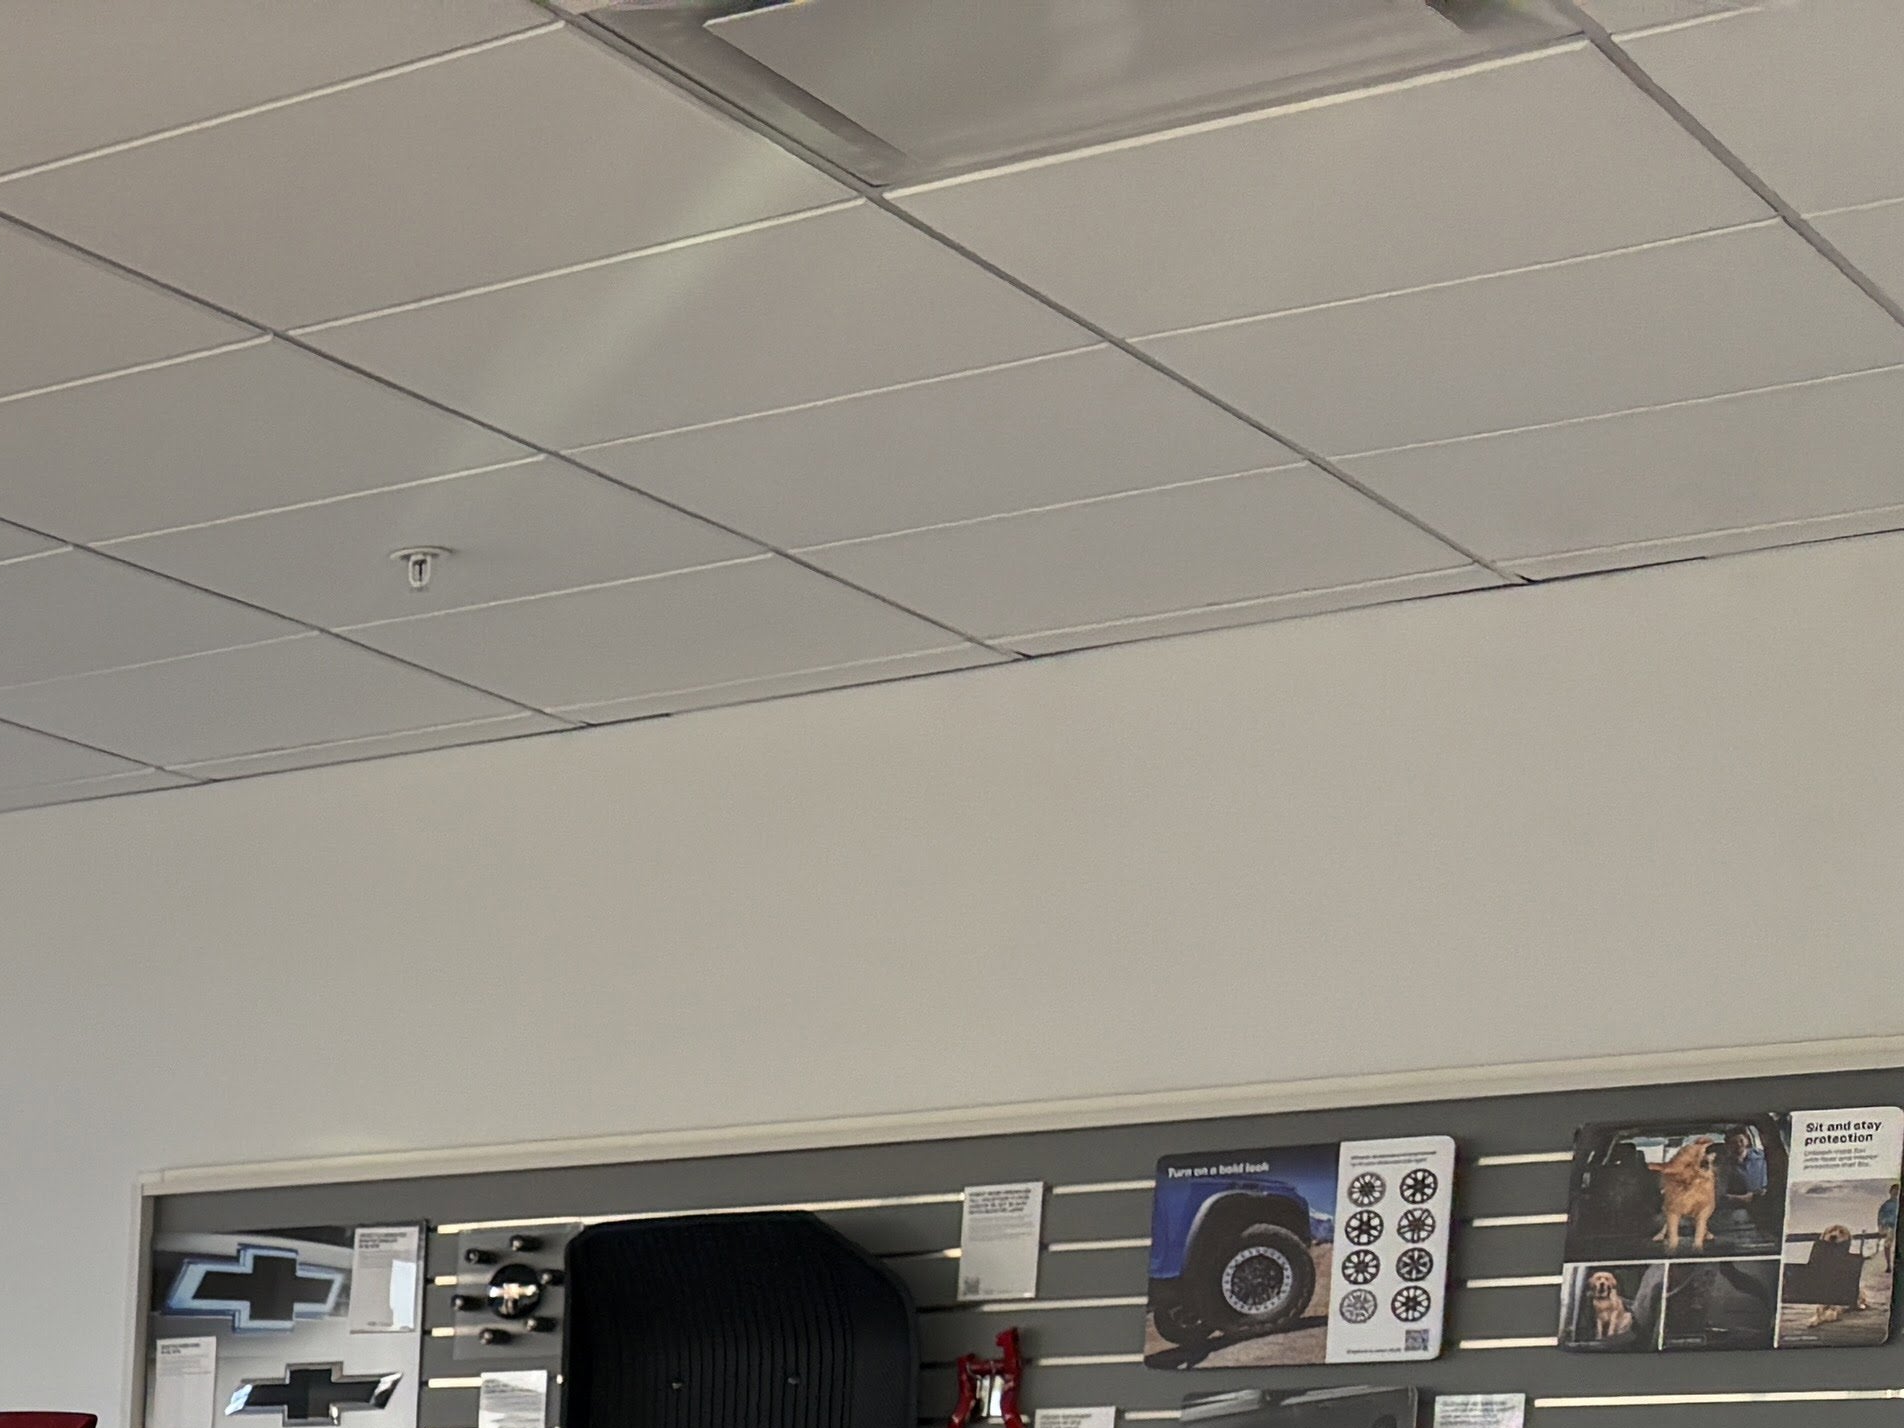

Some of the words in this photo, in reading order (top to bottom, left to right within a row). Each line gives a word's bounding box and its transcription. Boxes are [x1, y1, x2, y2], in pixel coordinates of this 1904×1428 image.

[1805, 1122, 1823, 1132] Sit
[1827, 1121, 1851, 1132] and
[1853, 1121, 1882, 1132] stay
[1804, 1132, 1873, 1147] protection
[1168, 1167, 1192, 1178] Turn
[1193, 1167, 1208, 1177] on
[1218, 1163, 1243, 1175] bold
[1245, 1161, 1270, 1173] look
